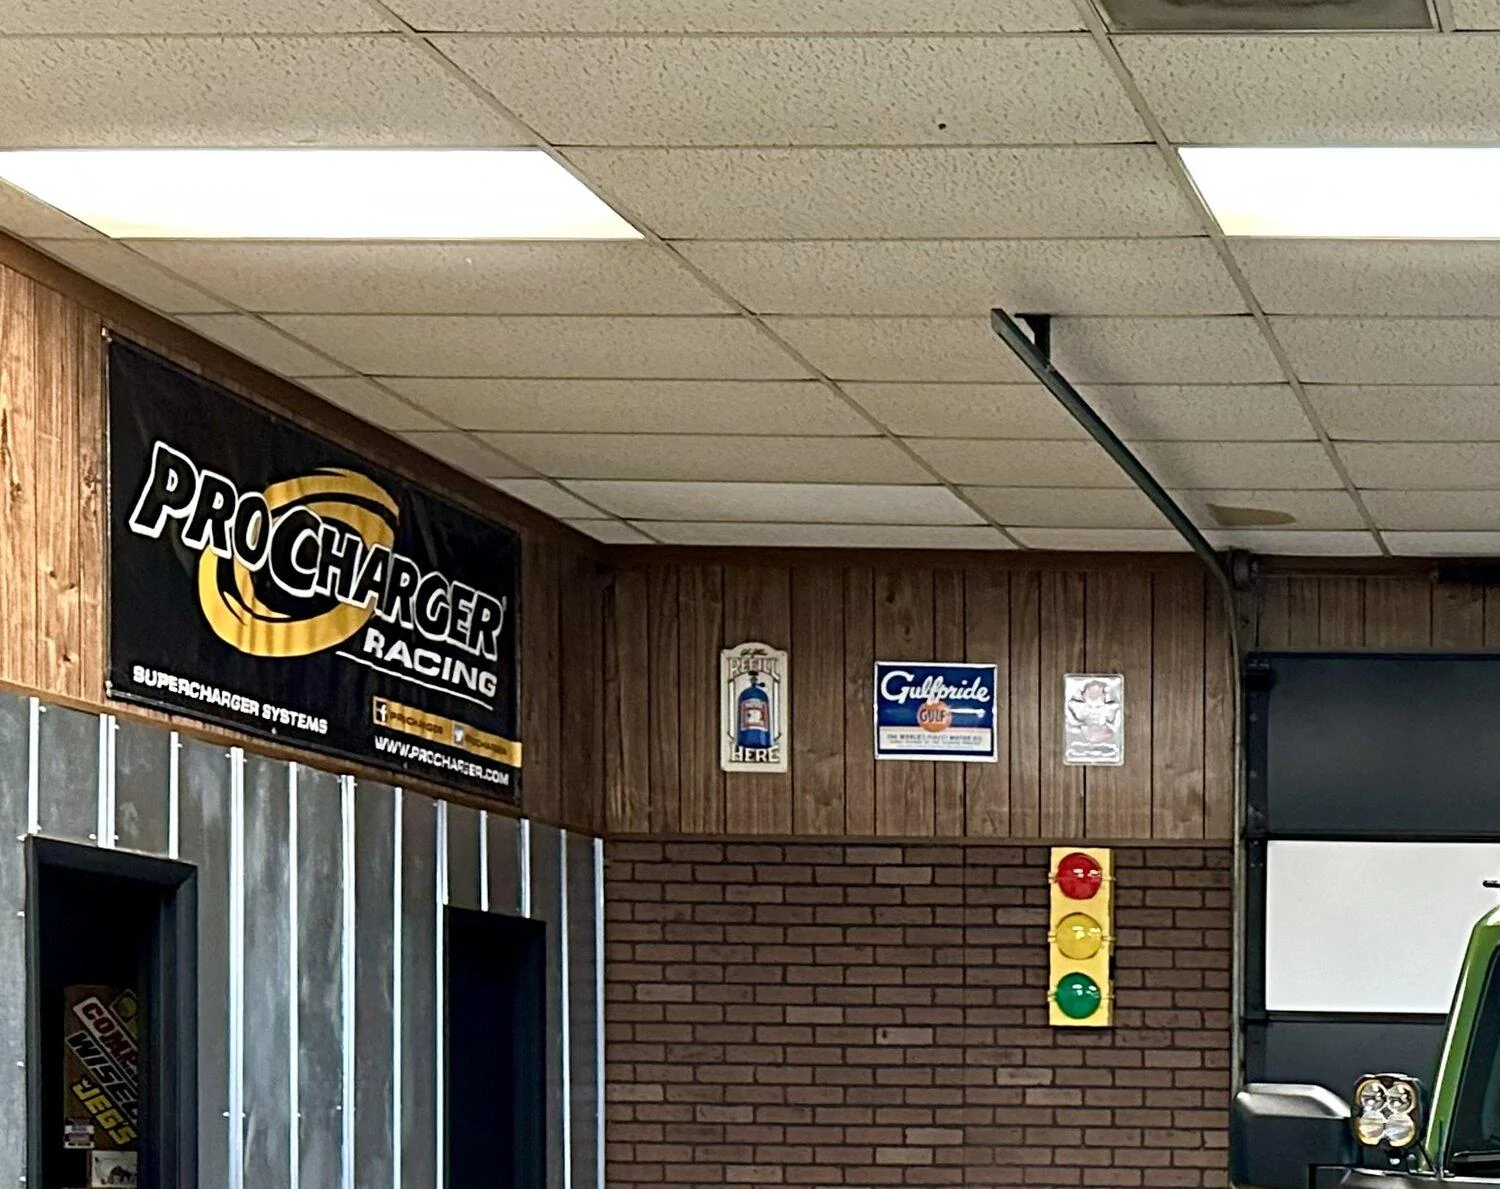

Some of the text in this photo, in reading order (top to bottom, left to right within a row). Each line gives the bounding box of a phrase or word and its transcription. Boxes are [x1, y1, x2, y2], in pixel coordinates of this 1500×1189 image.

[129, 440, 504, 661] PROCHARGER
[363, 626, 498, 698] RACING
[881, 670, 990, 704] Gulfpride
[133, 665, 328, 735] SUPERCHARGER SYSTEMS
[920, 708, 947, 723] GULF
[374, 734, 510, 786] WWW.PROCHARGER.COM
[729, 742, 780, 763] HERE
